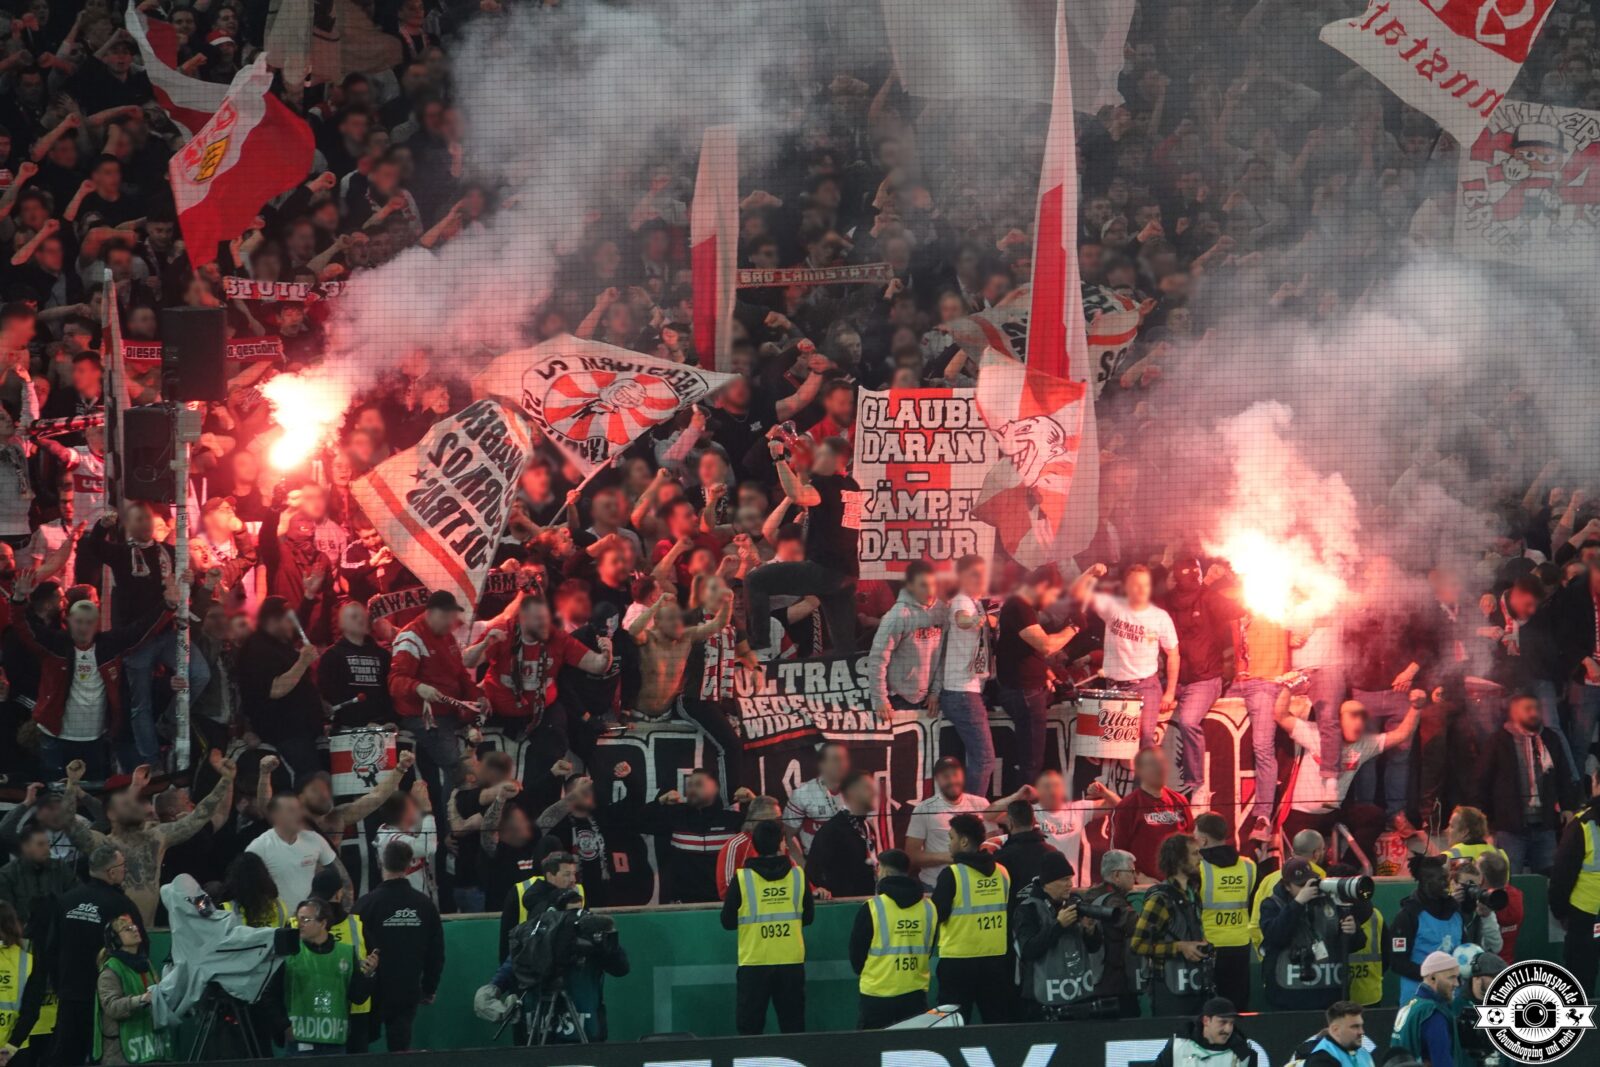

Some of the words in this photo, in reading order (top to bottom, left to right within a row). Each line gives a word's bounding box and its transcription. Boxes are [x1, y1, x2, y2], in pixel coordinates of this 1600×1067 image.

[740, 270, 775, 283] BAD
[861, 431, 986, 464] DARAN
[859, 521, 979, 561] DAFÜR
[977, 878, 998, 888] SDS
[1220, 875, 1243, 885] SDS
[762, 887, 788, 897] SDS
[394, 909, 417, 918] SDS
[1215, 911, 1243, 926] 0780
[896, 919, 919, 929] SDS
[976, 914, 1003, 931] 1212
[760, 923, 791, 939] 0932
